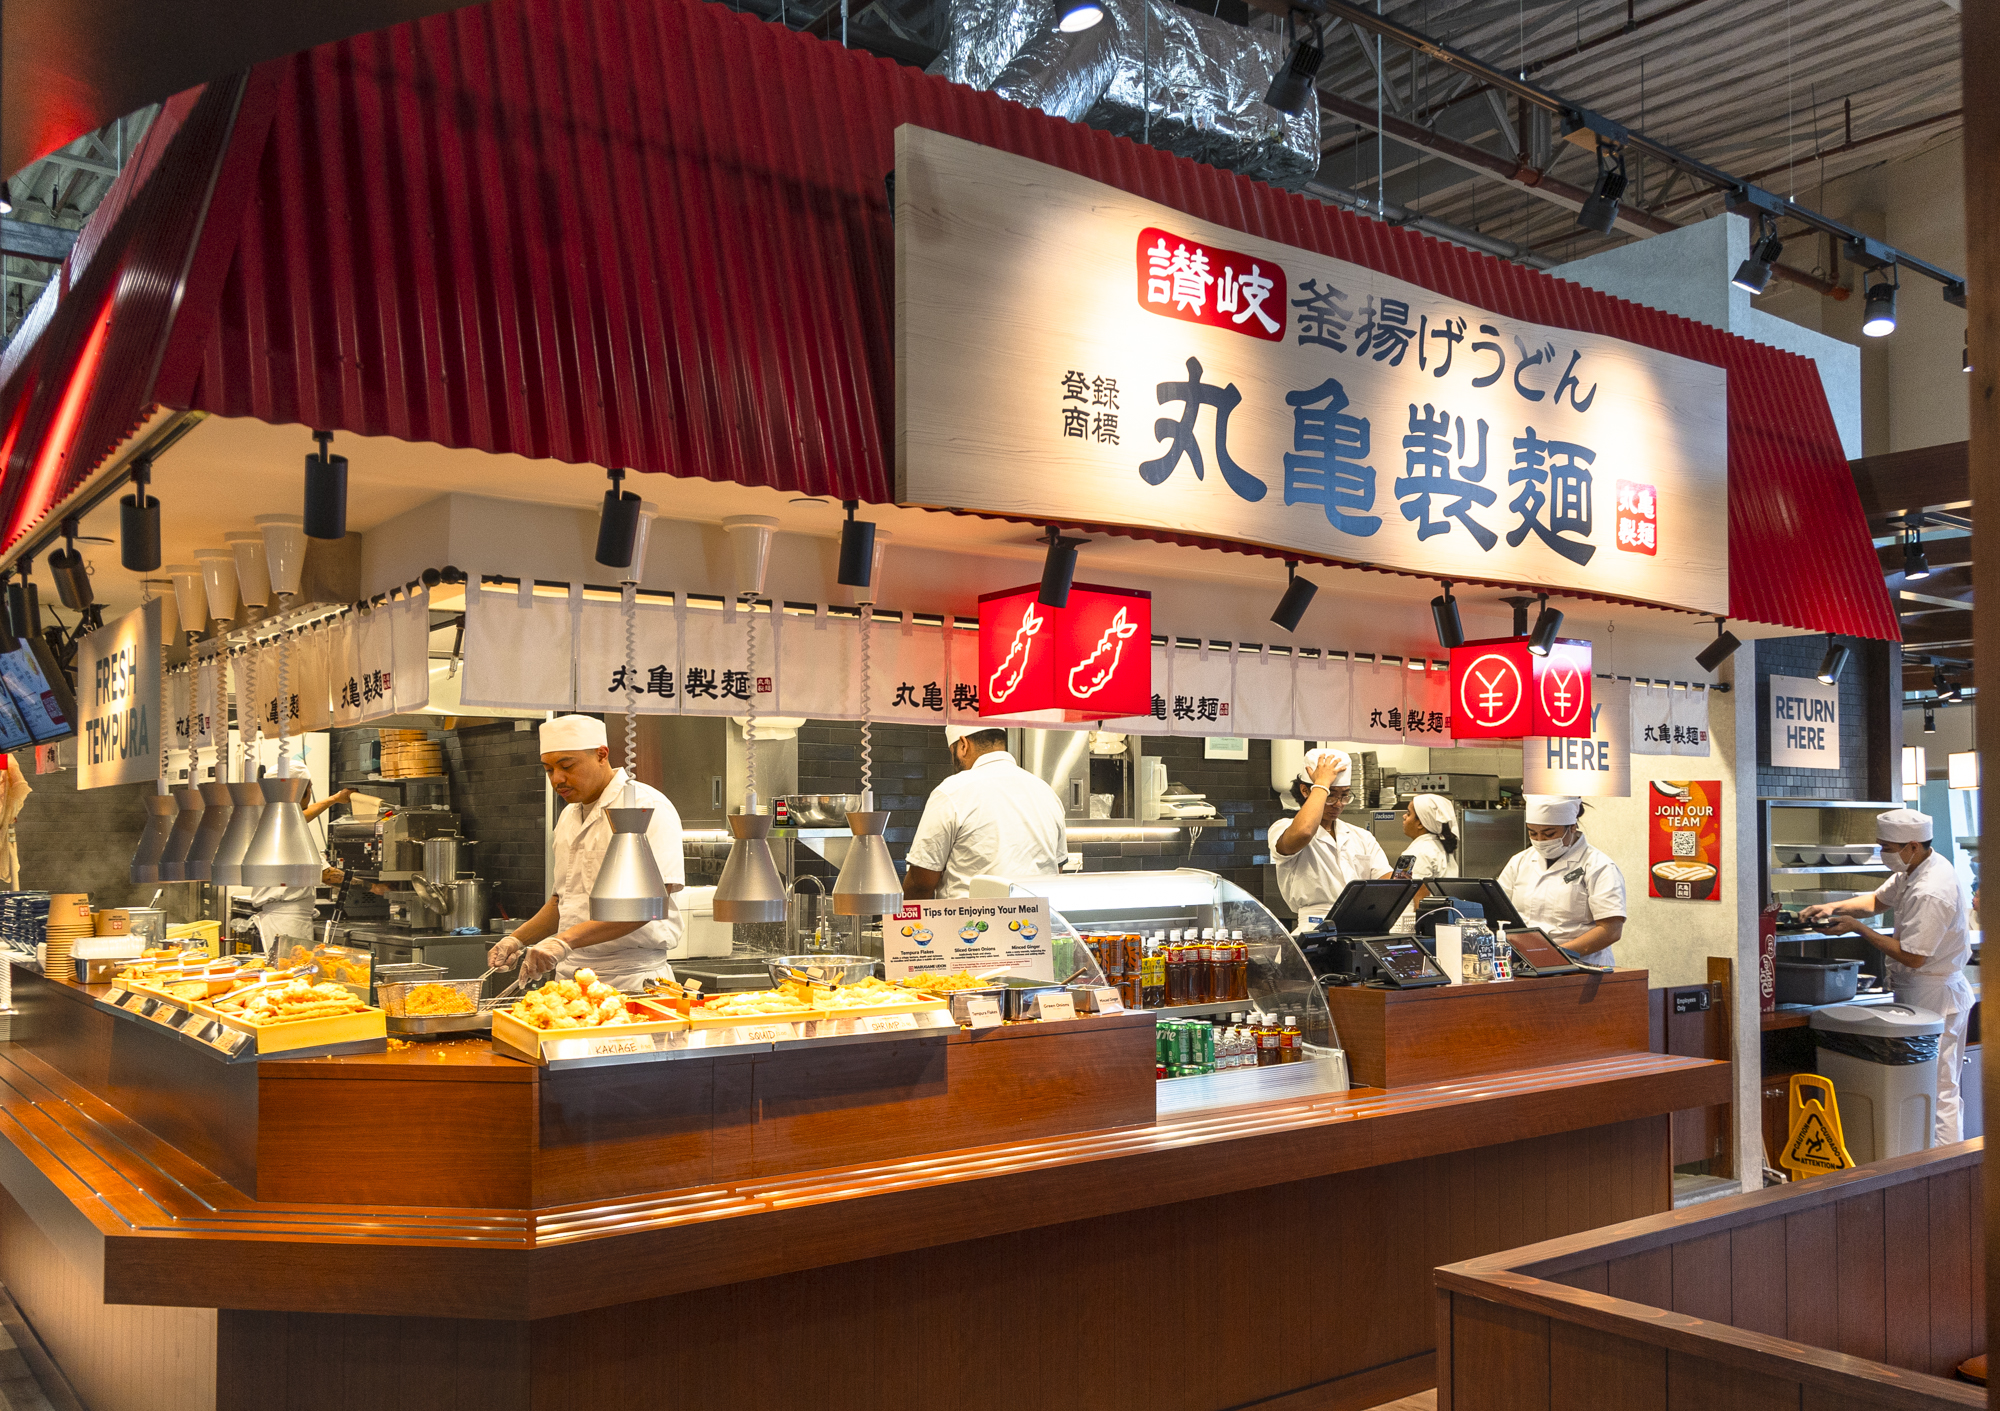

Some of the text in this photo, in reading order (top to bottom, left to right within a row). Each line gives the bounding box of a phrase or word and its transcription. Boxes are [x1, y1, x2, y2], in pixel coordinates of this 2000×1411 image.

[1291, 278, 1597, 413] 釜揚げうどん
[1061, 370, 1119, 410] 登録
[1062, 405, 1120, 446] 商標
[1138, 356, 1597, 567] 丸亀製麺
[96, 644, 137, 707] FRESH
[607, 664, 752, 700] 丸亀製麺
[892, 681, 980, 712] 丸亀製
[1142, 693, 1219, 722] 亀製麺
[1776, 696, 1835, 723] RETURN
[1370, 706, 1443, 734] 丸亀製麺
[85, 704, 149, 766] TEMPURA
[1787, 725, 1825, 750] HERE
[1547, 737, 1610, 771] HERE
[1655, 805, 1713, 816] JOIN OUR
[1667, 816, 1700, 827] TEAM
[896, 911, 918, 919] UDON
[923, 904, 1039, 919] Tips for Enjoying Your Meal
[749, 1030, 776, 1041] SQUID
[871, 1020, 900, 1031] SHRIMP
[595, 1043, 638, 1055] KAKIAGE
[1794, 1123, 1810, 1150] CAUTION
[1821, 1126, 1841, 1157] CUIDADO
[1801, 1158, 1836, 1170] ATTENTION
